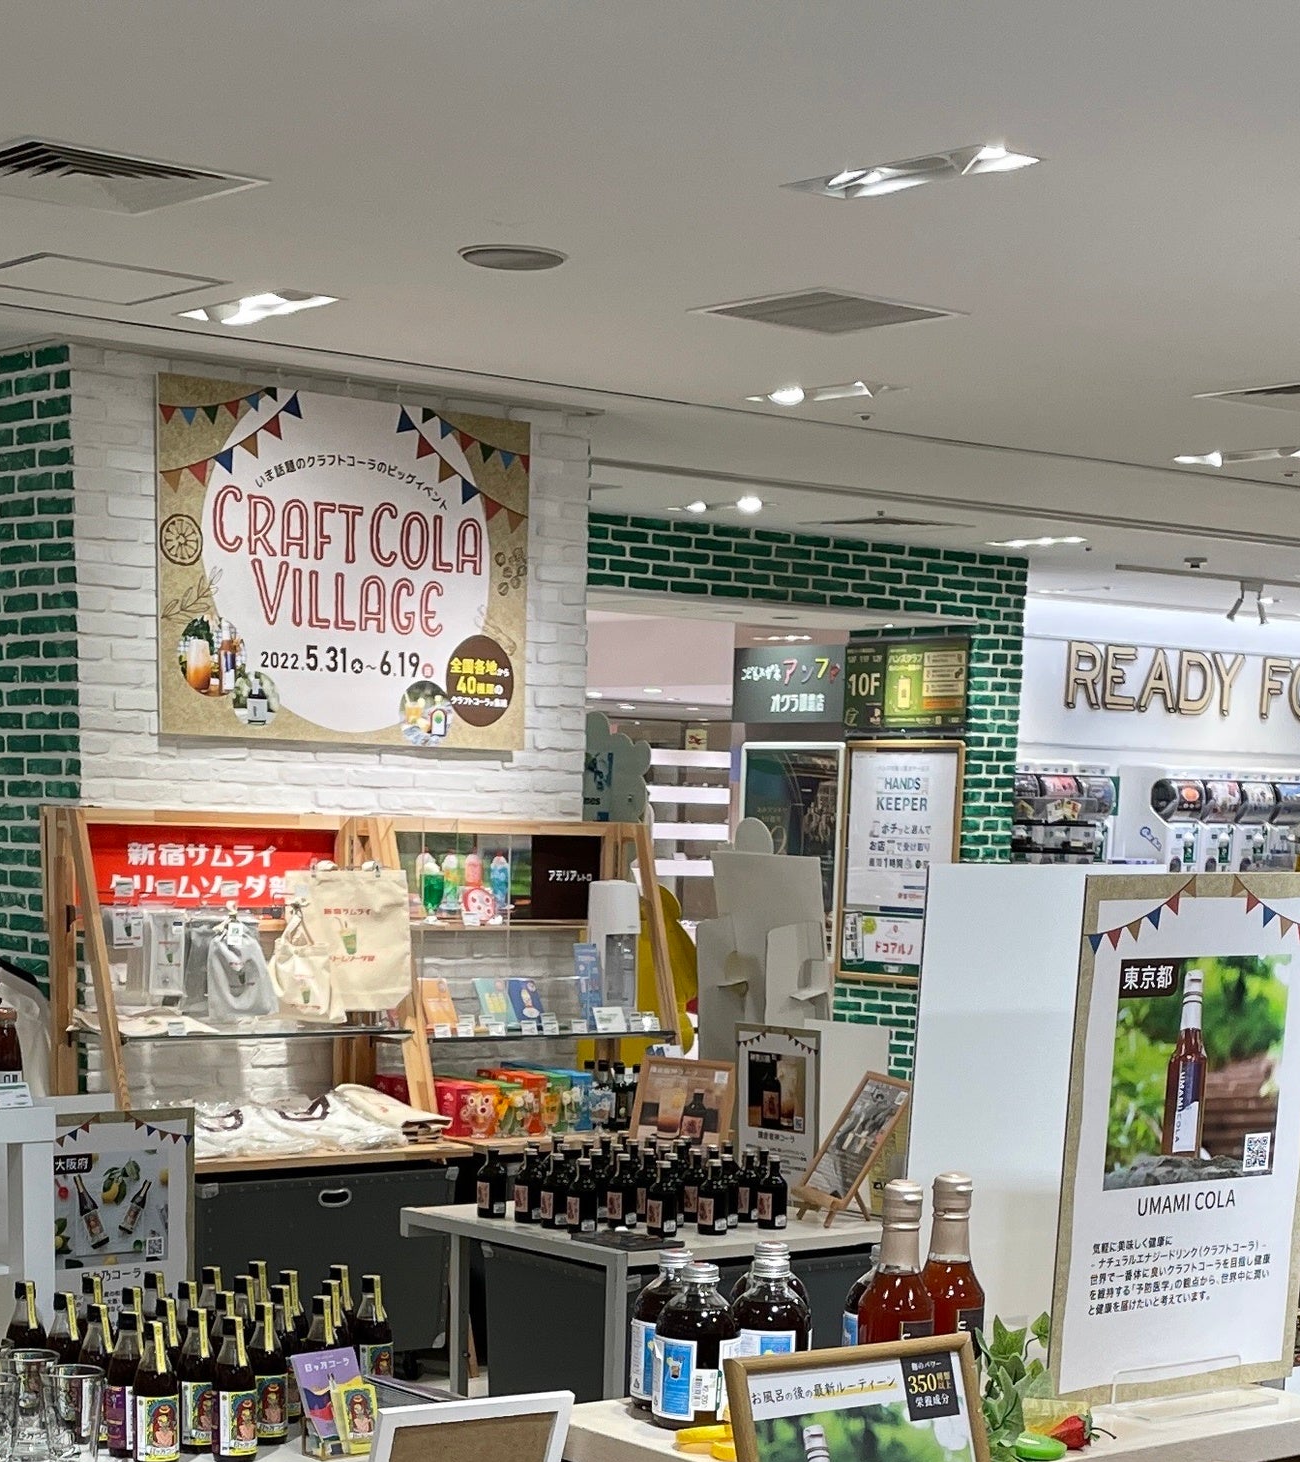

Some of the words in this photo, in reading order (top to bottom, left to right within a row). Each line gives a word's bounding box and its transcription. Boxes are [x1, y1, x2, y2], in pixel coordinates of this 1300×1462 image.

[255, 453, 449, 511] いま話題のクラフトコーラのビッグイベント
[212, 484, 363, 565] CRAFT
[370, 502, 483, 576] COLA
[251, 558, 444, 638] VILLAGE
[848, 673, 881, 697] 10F
[1063, 640, 1246, 717] READY
[884, 777, 921, 791] HANDS
[876, 796, 928, 812] KEEPER
[127, 842, 277, 868] 新宿サムライ
[1122, 965, 1174, 990] 東京都
[55, 1157, 91, 1171] 大阪府
[1137, 1193, 1190, 1217] UMAMI
[1195, 1189, 1236, 1211] COLA
[1092, 1236, 1173, 1255] 気軽に美味しく健康に
[1090, 1253, 1271, 1286] 世界で一番体に良いクラフトコーラを目指し健康
[1088, 1291, 1211, 1316] と健康を届けたいと考えています。
[751, 1375, 897, 1405] お風呂の後の最新ルーティーン
[908, 1373, 937, 1395] 350
[915, 1394, 950, 1409] 栄養成分
